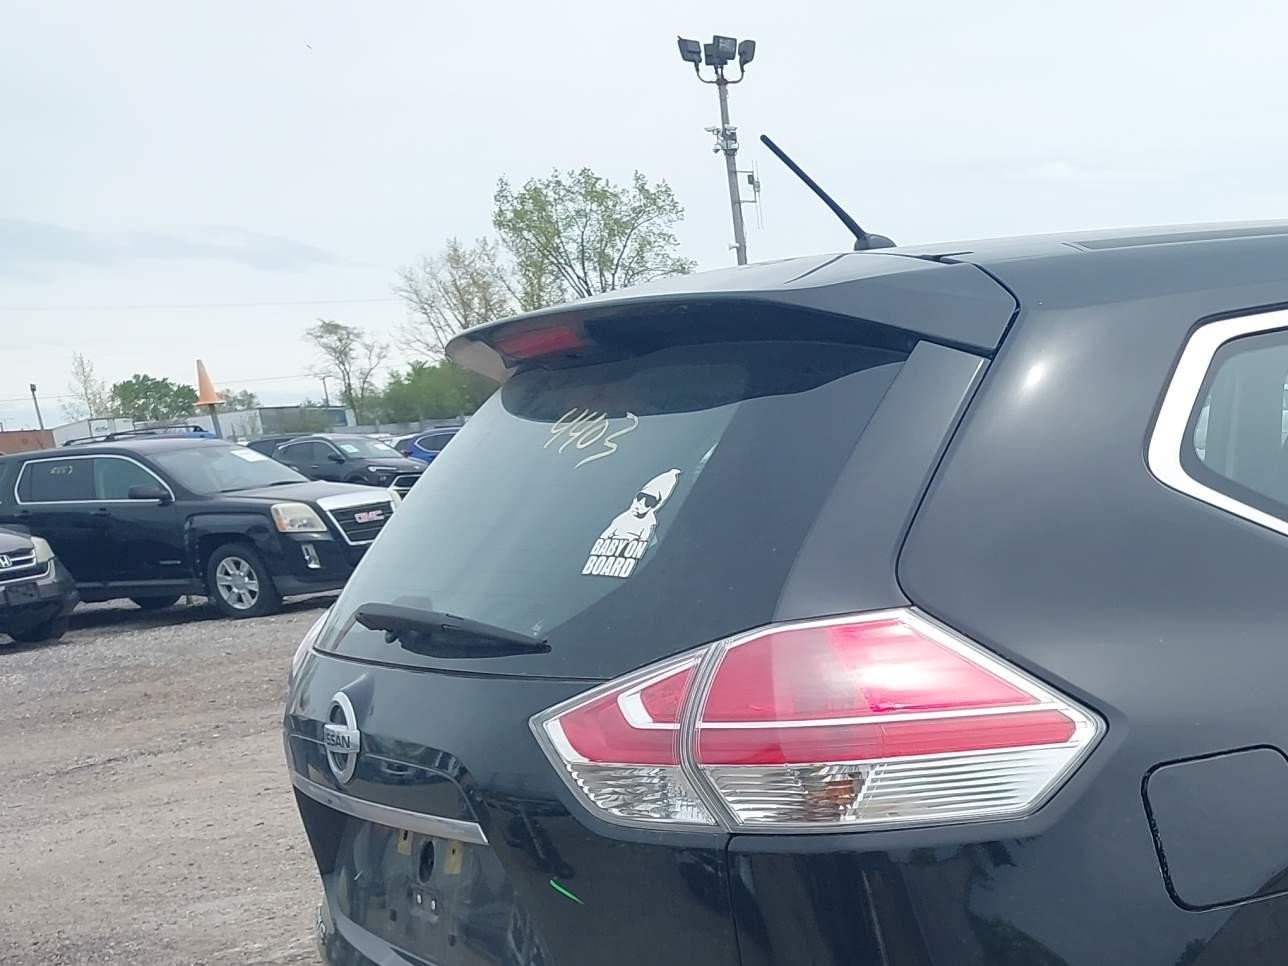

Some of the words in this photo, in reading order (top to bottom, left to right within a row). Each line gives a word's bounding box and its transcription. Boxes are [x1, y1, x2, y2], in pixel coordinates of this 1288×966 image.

[544, 407, 639, 469] 4403
[590, 538, 630, 556] BABY
[624, 540, 648, 559] ON
[581, 556, 636, 577] BOARD
